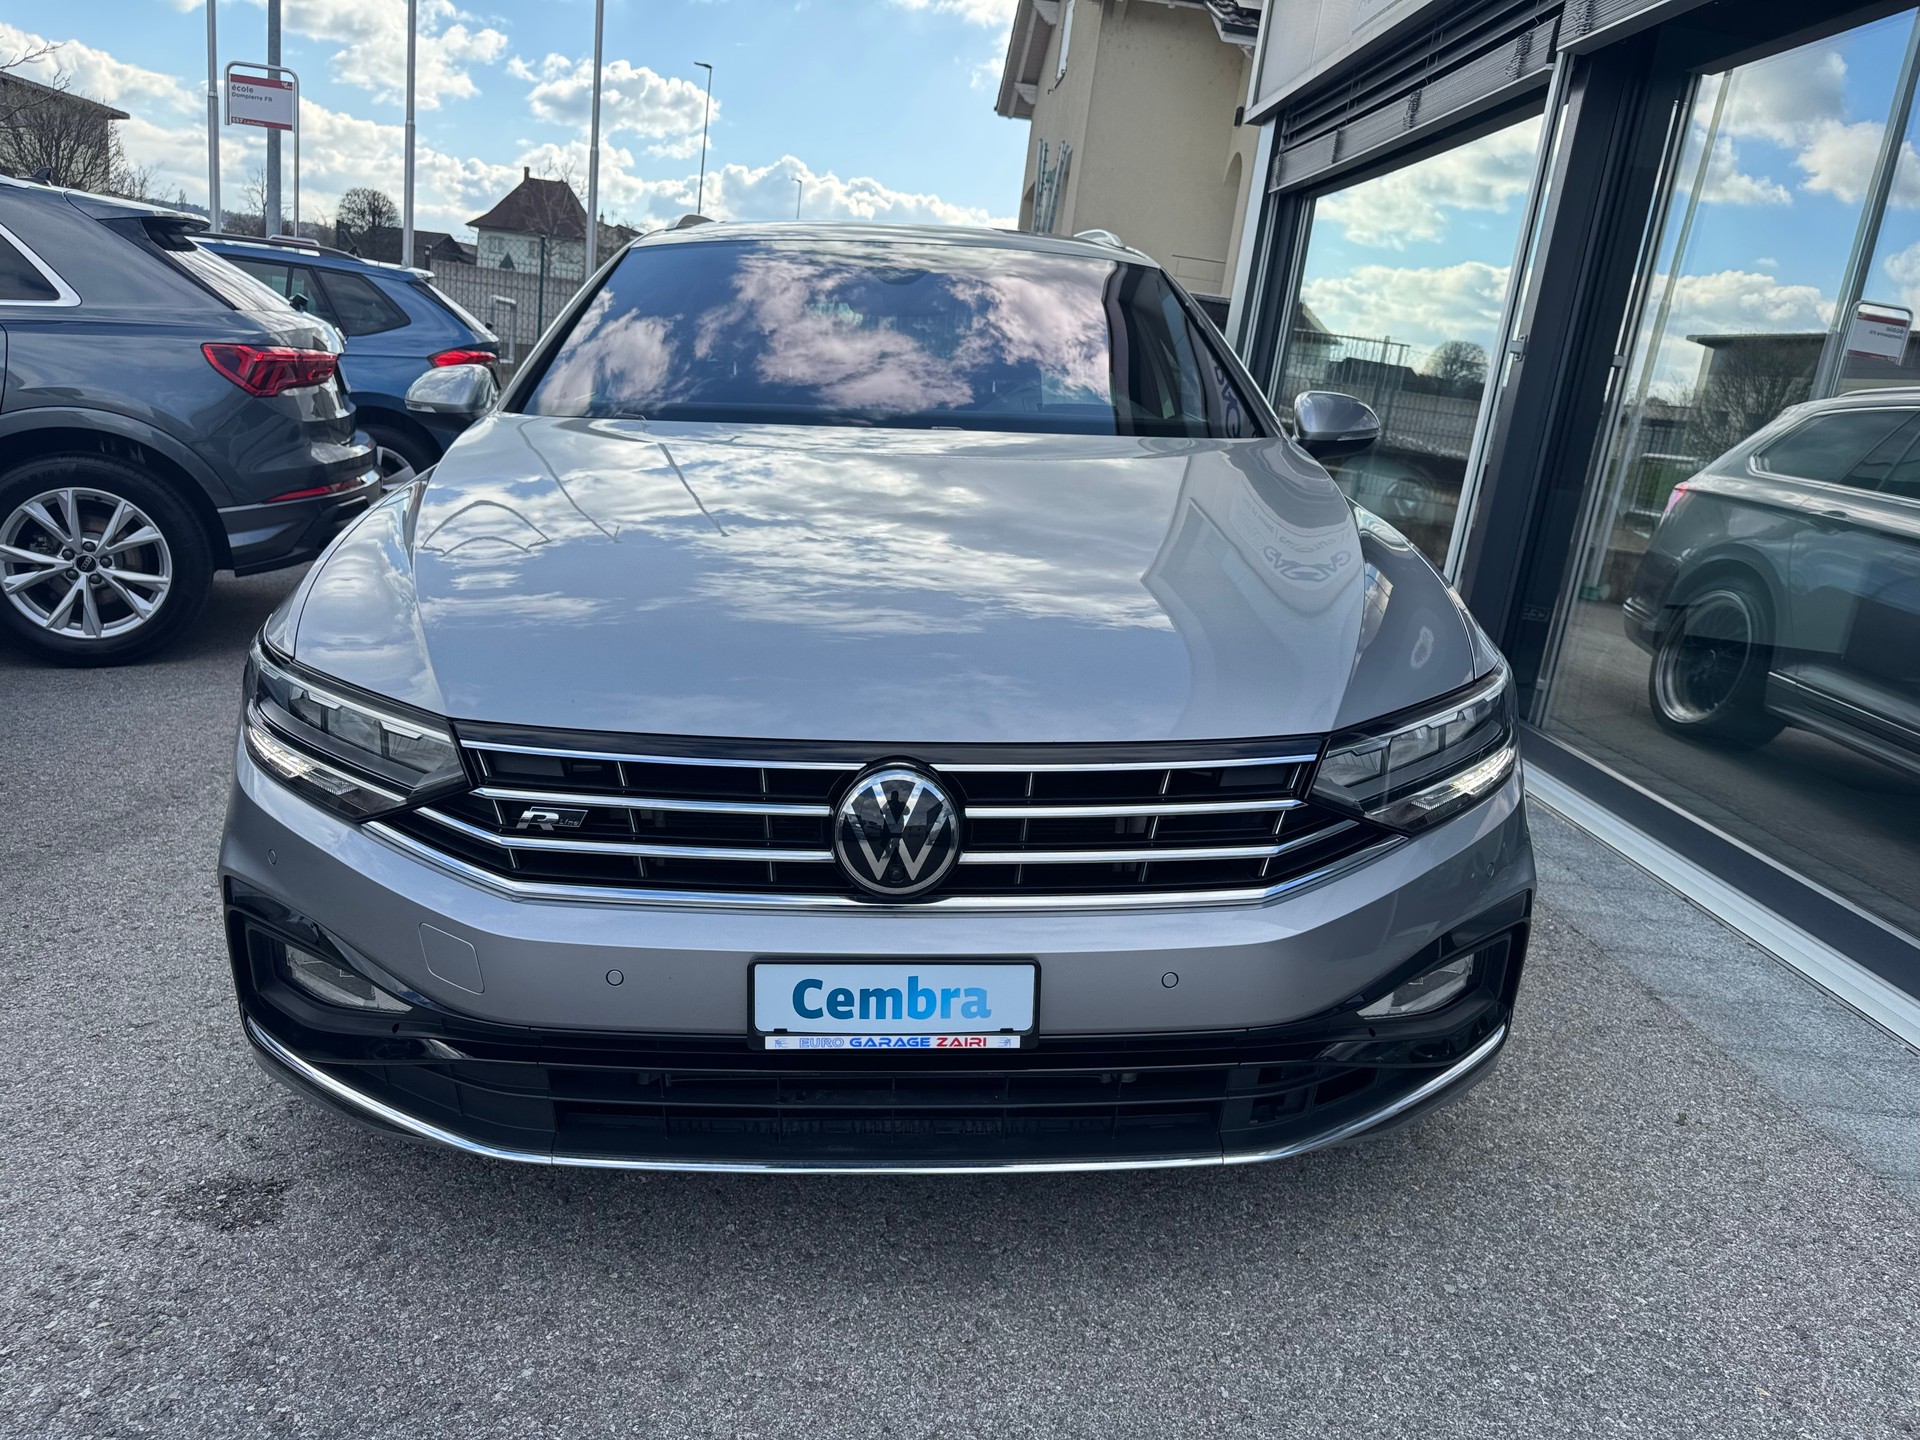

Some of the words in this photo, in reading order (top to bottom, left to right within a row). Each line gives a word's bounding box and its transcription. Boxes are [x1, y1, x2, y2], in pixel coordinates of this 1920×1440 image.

[231, 92, 263, 101] Dompierre
[792, 976, 992, 1020] Cembra
[800, 1037, 845, 1048] EURO
[849, 1037, 931, 1048] GARAGE
[936, 1037, 987, 1048] ZAIRI
